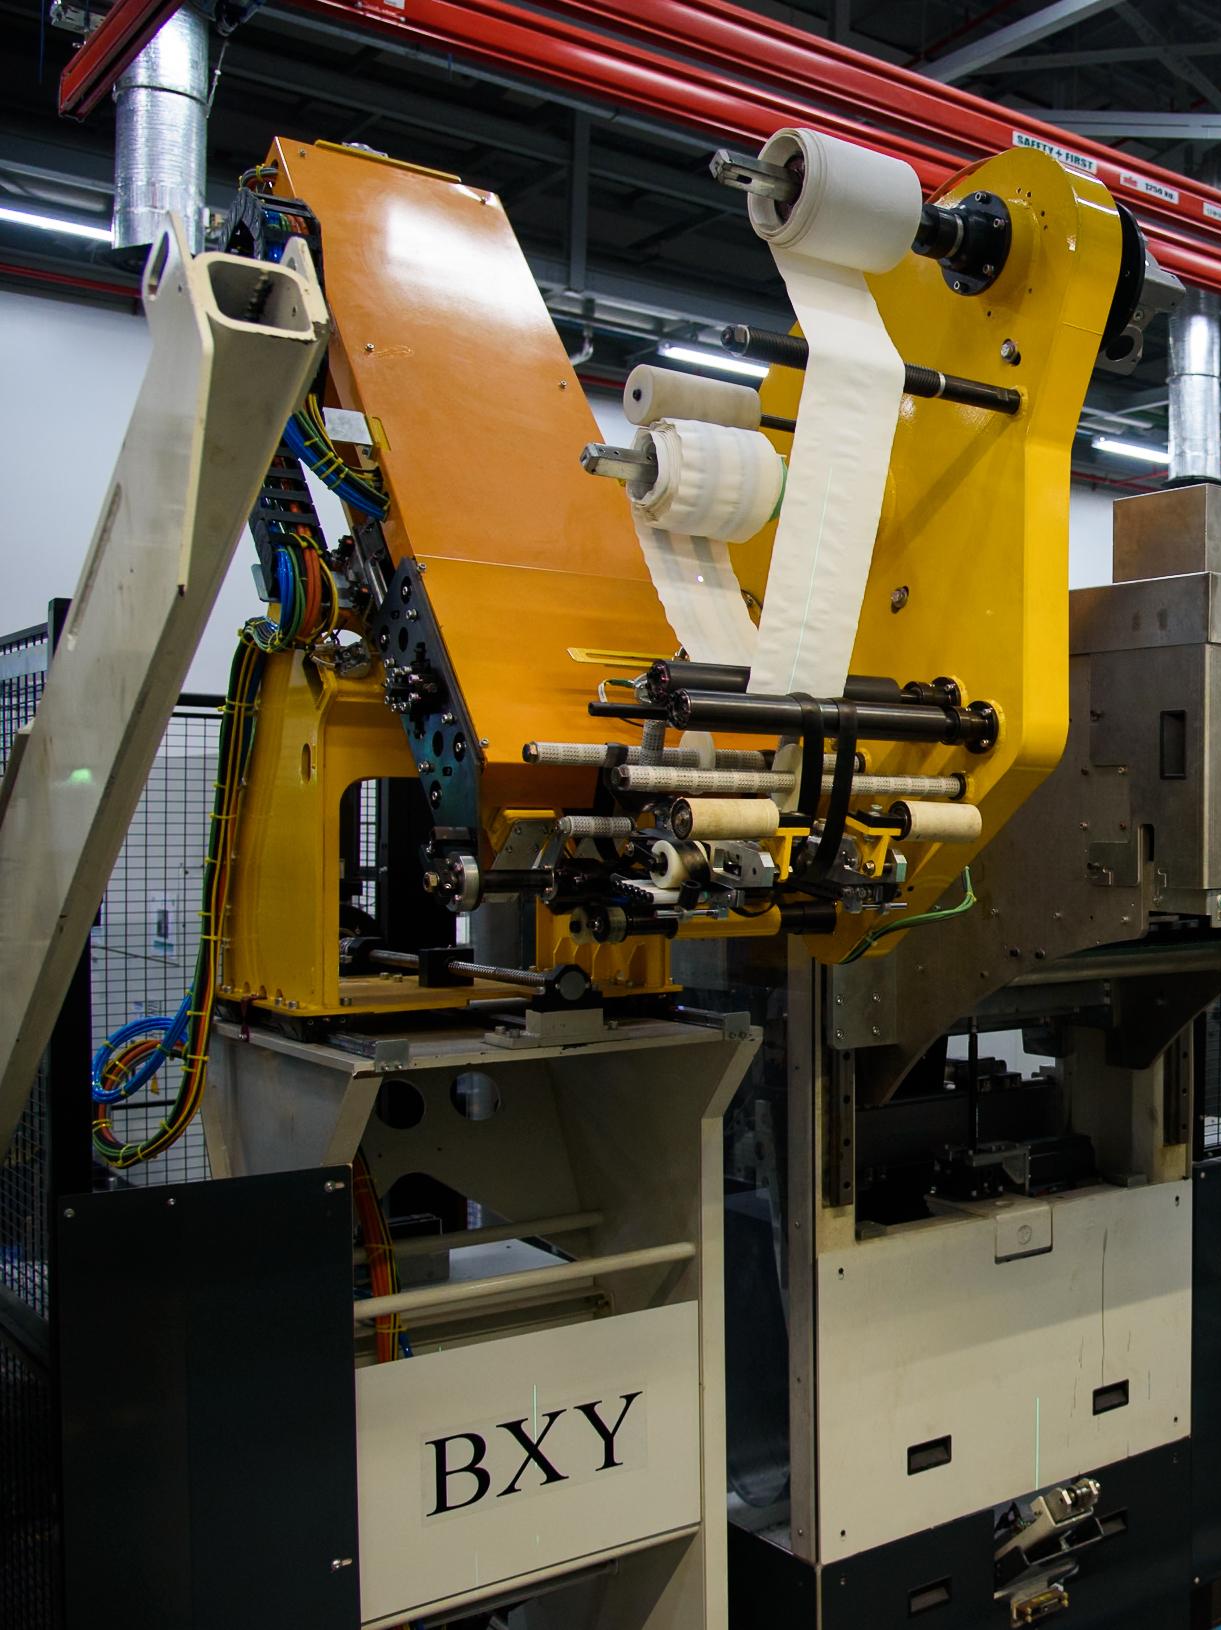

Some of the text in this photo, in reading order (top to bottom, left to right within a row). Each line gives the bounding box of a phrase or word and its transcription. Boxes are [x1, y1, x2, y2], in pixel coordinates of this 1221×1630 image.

[1016, 134, 1093, 170] SAFETY FIRST
[425, 1391, 643, 1517] BXY
